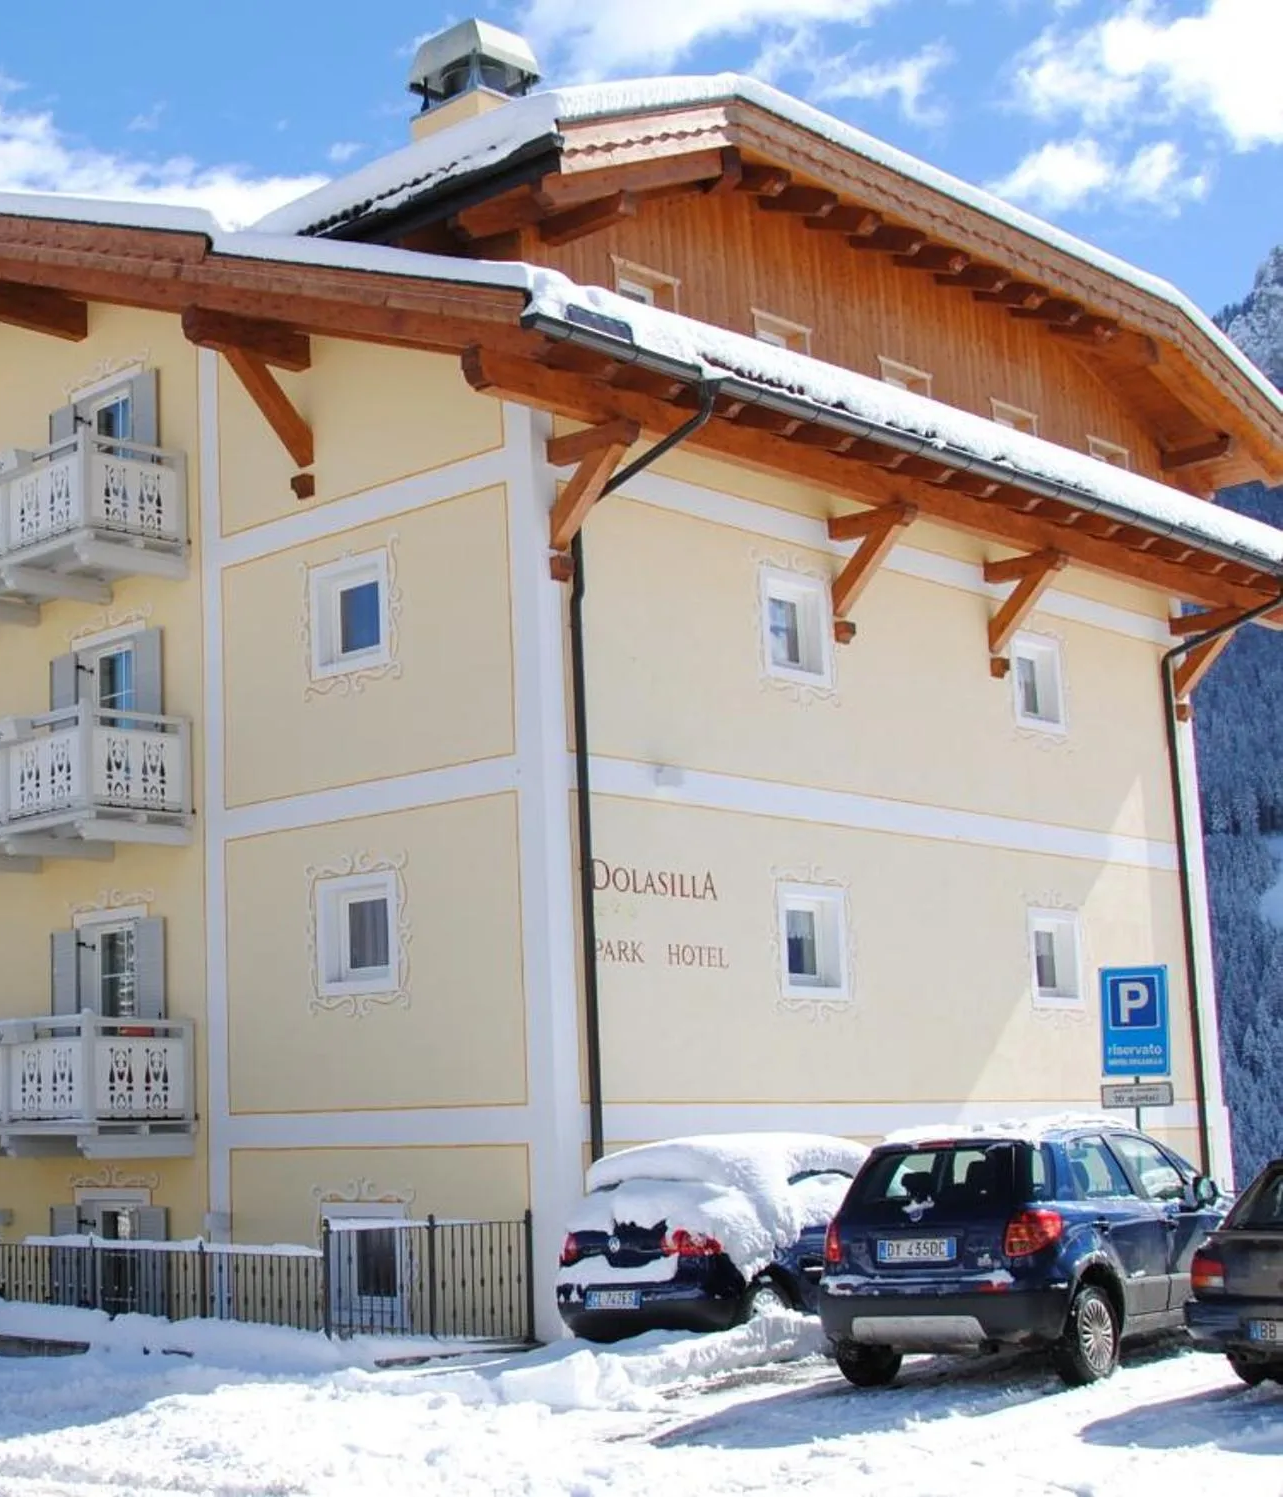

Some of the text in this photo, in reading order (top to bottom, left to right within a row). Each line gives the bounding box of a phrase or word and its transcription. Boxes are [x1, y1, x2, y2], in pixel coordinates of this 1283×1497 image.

[592, 858, 718, 901] DOLASILLA
[596, 939, 730, 969] PARK HOTEL
[1119, 981, 1149, 1024] P
[1108, 1043, 1163, 1056] riservato
